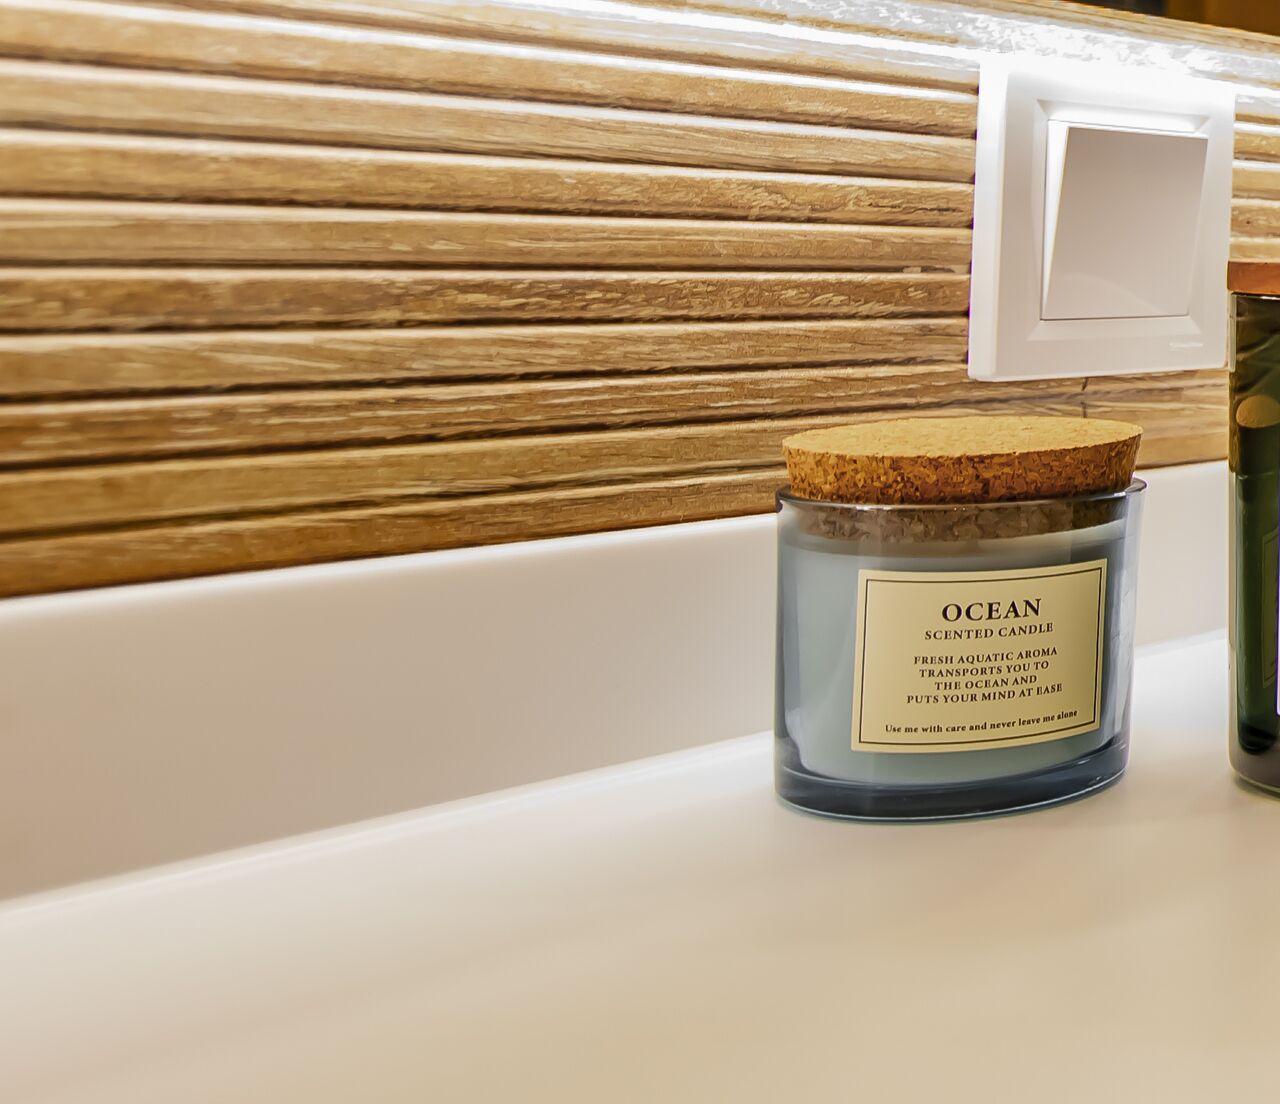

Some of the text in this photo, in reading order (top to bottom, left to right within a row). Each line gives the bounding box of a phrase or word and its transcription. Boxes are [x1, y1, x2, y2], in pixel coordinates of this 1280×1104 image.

[941, 598, 1042, 622] OCEAN
[924, 622, 1054, 640] SCENTED CANDLE
[913, 647, 1058, 665] FRESH AQUATIC AROMA
[919, 660, 1049, 678] TRANSPORTS YOU TO
[934, 674, 1038, 691] THE OCEAN AND
[906, 683, 1063, 704] PUTS YOUR MIND AT EASE
[885, 708, 1078, 734] Use me with care and never leave me alone
